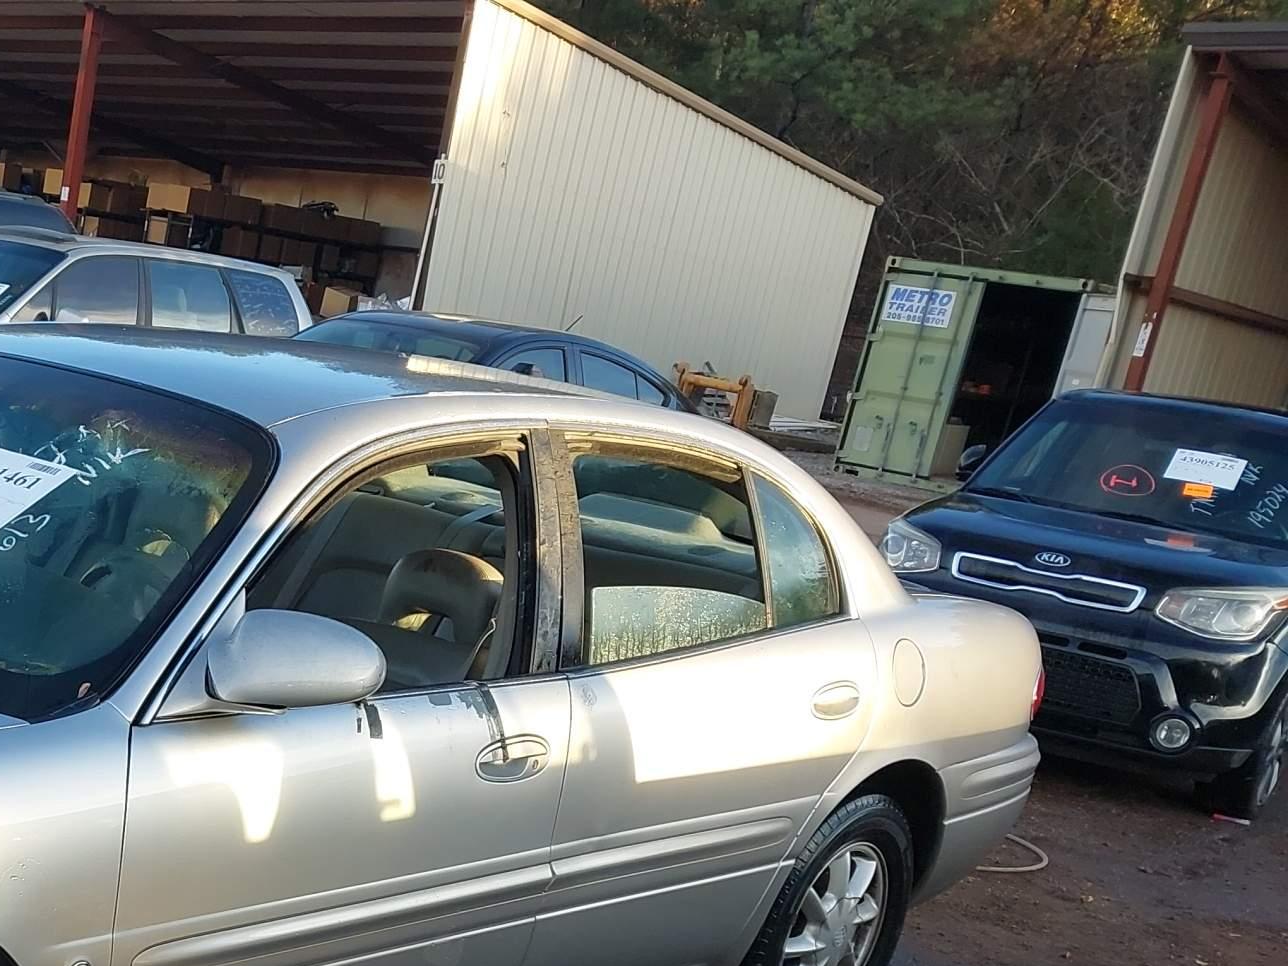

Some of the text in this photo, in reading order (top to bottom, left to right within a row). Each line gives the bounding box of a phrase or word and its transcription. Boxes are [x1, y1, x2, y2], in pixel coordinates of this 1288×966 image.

[433, 163, 446, 180] 10
[890, 287, 953, 306] METRO
[1040, 552, 1065, 565] KIA
